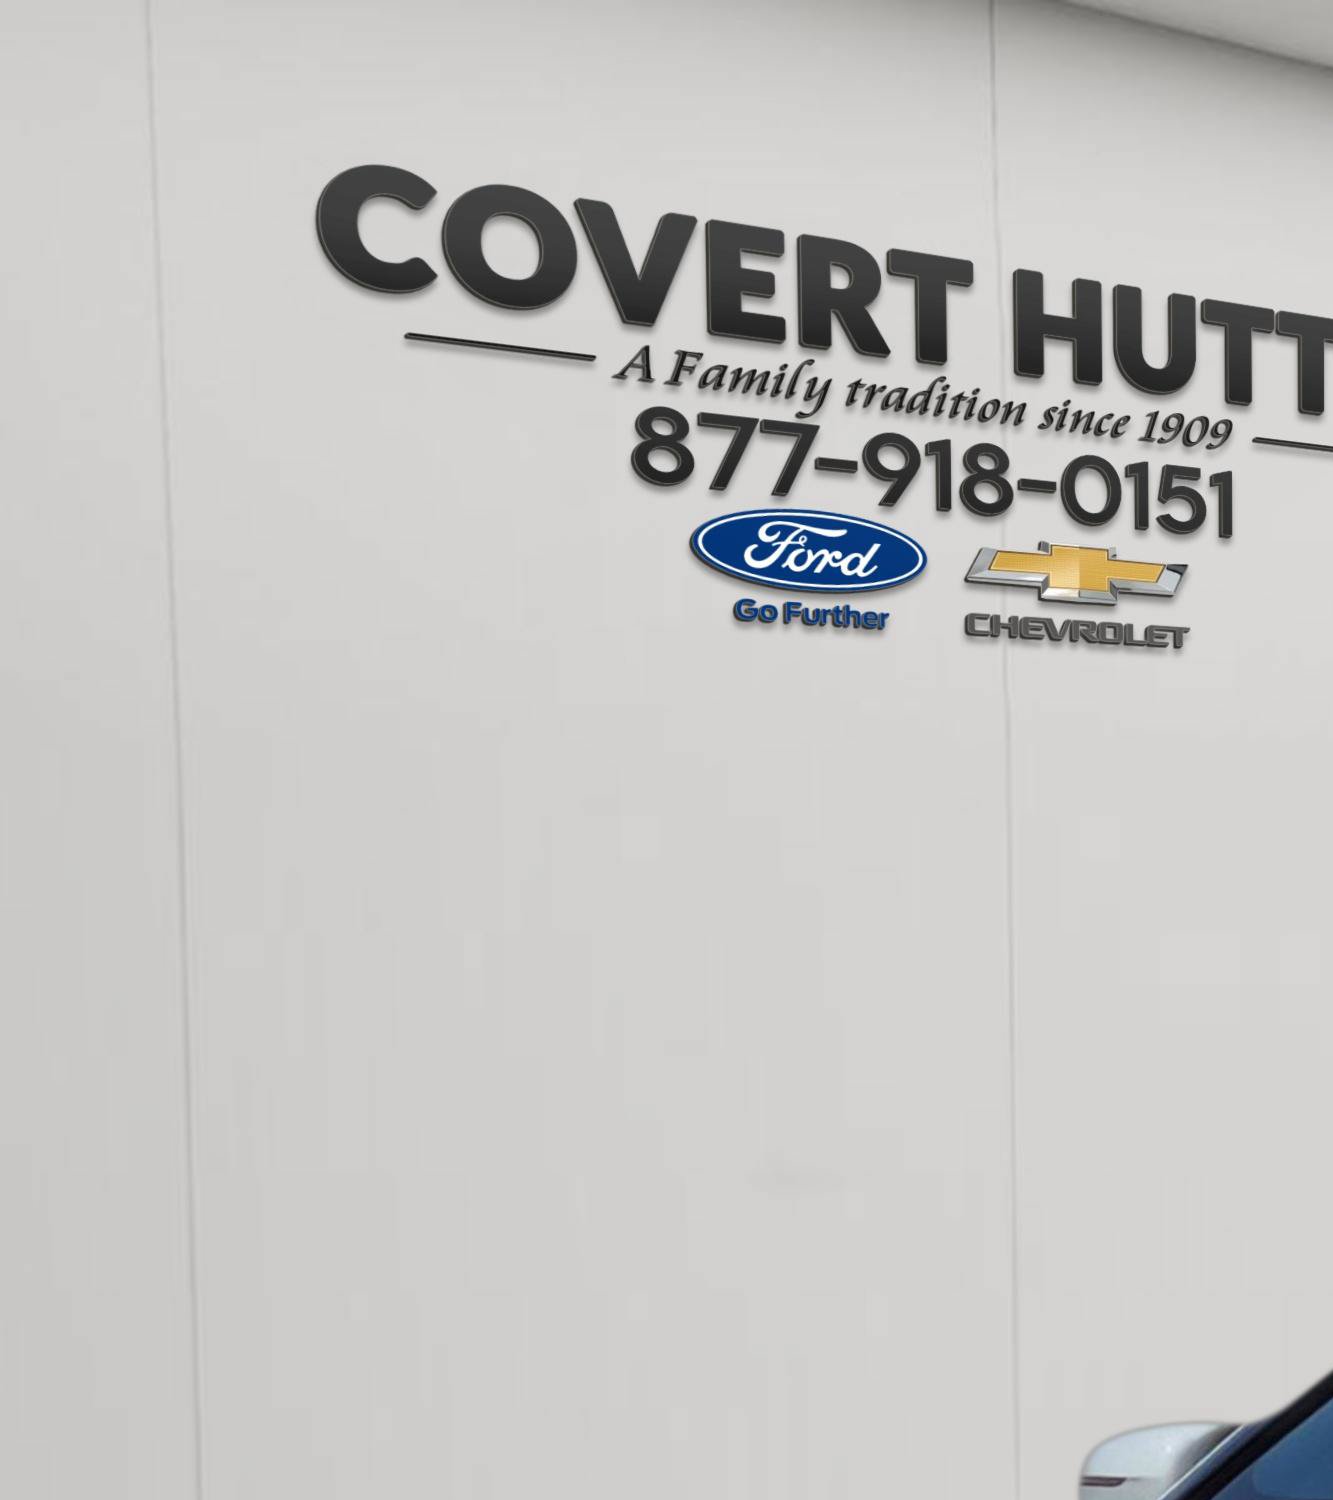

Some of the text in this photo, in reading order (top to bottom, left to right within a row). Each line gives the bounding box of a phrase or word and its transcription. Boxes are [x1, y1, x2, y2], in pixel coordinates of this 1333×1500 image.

[316, 165, 973, 366] COVERT
[612, 345, 1234, 451] A Family tradition since 1909
[631, 407, 1233, 540] 877-918-0151
[743, 520, 880, 578] Ford
[733, 599, 890, 631] Go Further
[964, 612, 1191, 649] CHEVROLET
